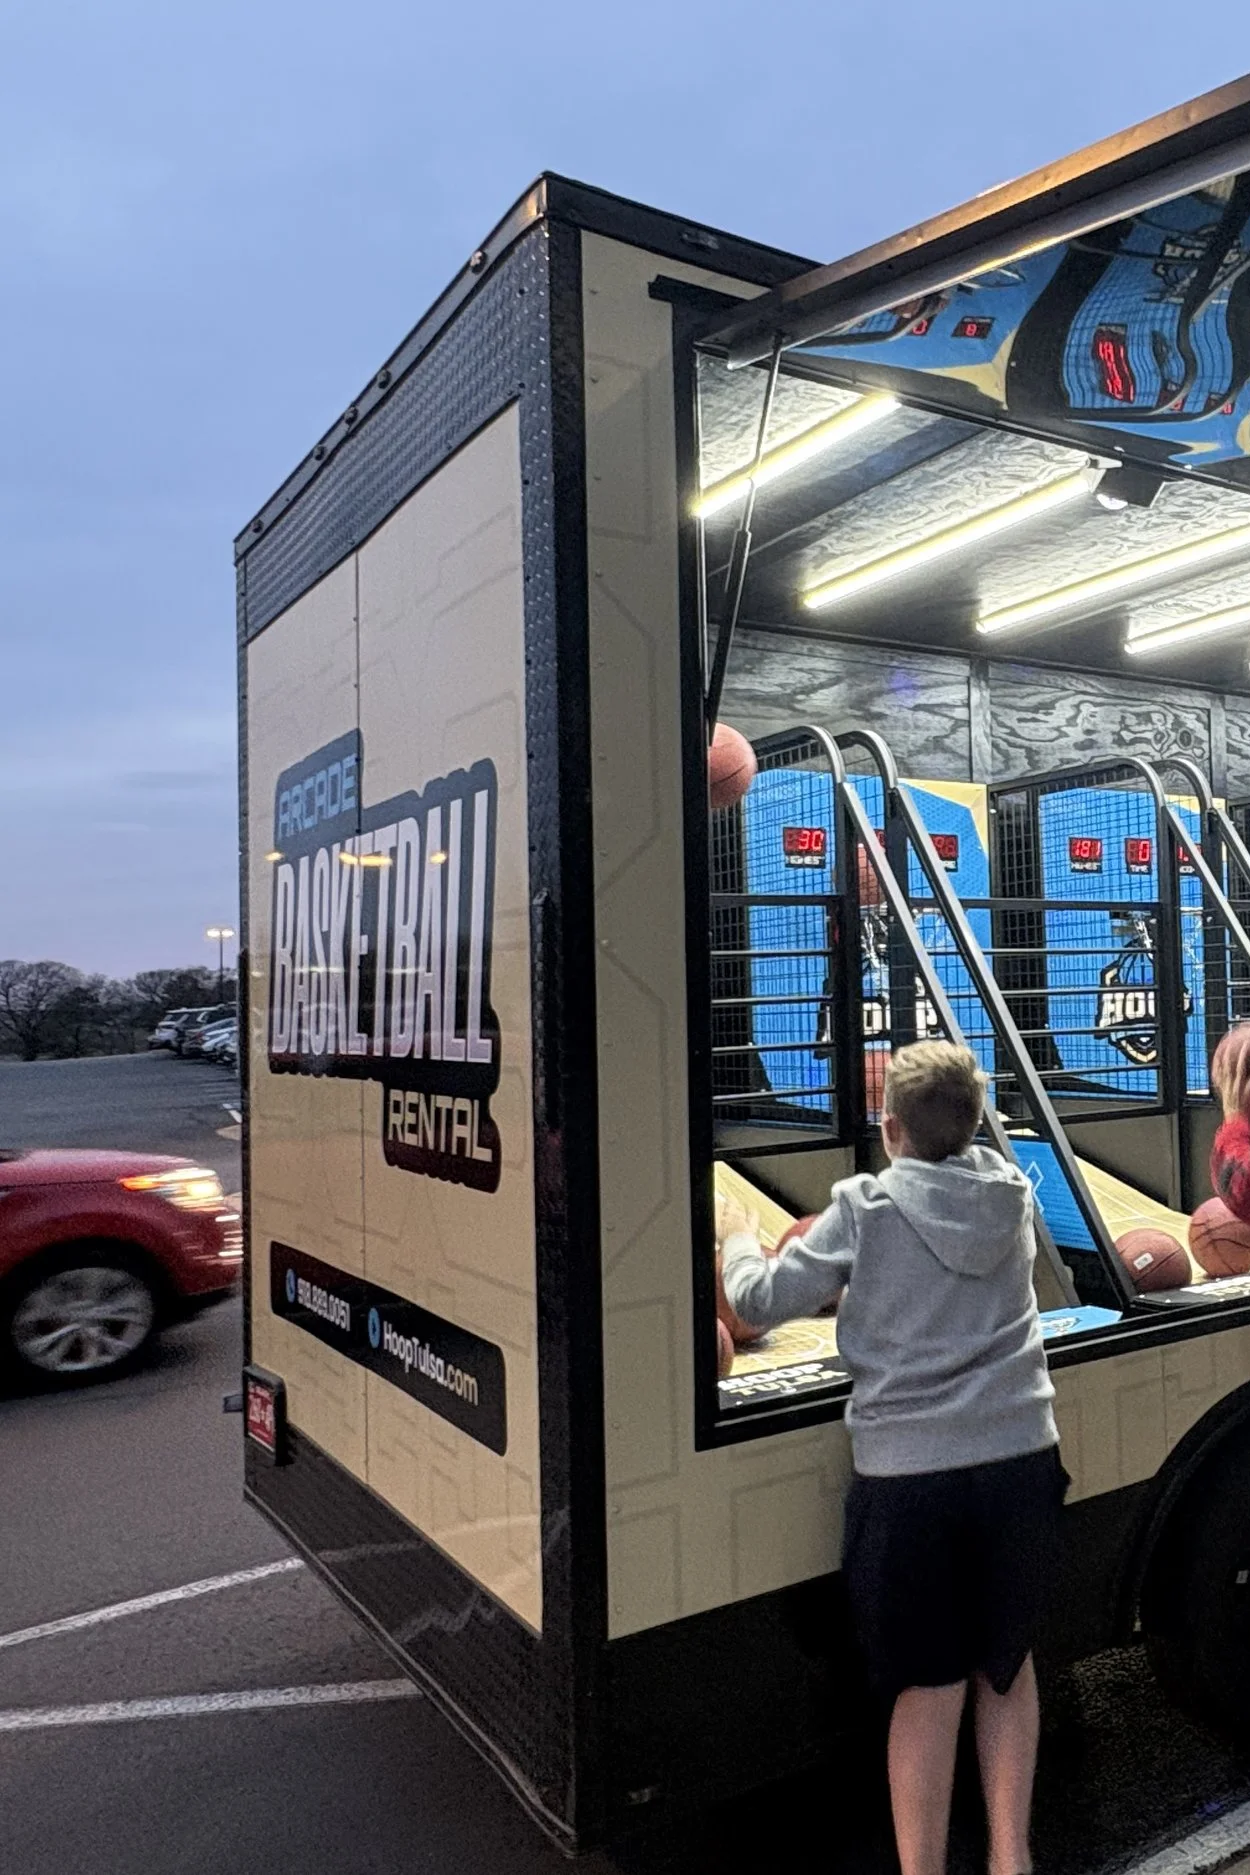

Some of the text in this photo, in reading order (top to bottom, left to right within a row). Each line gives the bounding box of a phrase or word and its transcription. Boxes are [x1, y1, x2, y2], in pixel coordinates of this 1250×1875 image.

[278, 753, 358, 840] ARCADE
[272, 789, 492, 1063] BASKETBALL
[388, 1089, 493, 1162] RENTAL
[383, 1320, 478, 1407] HoopTulsa.com
